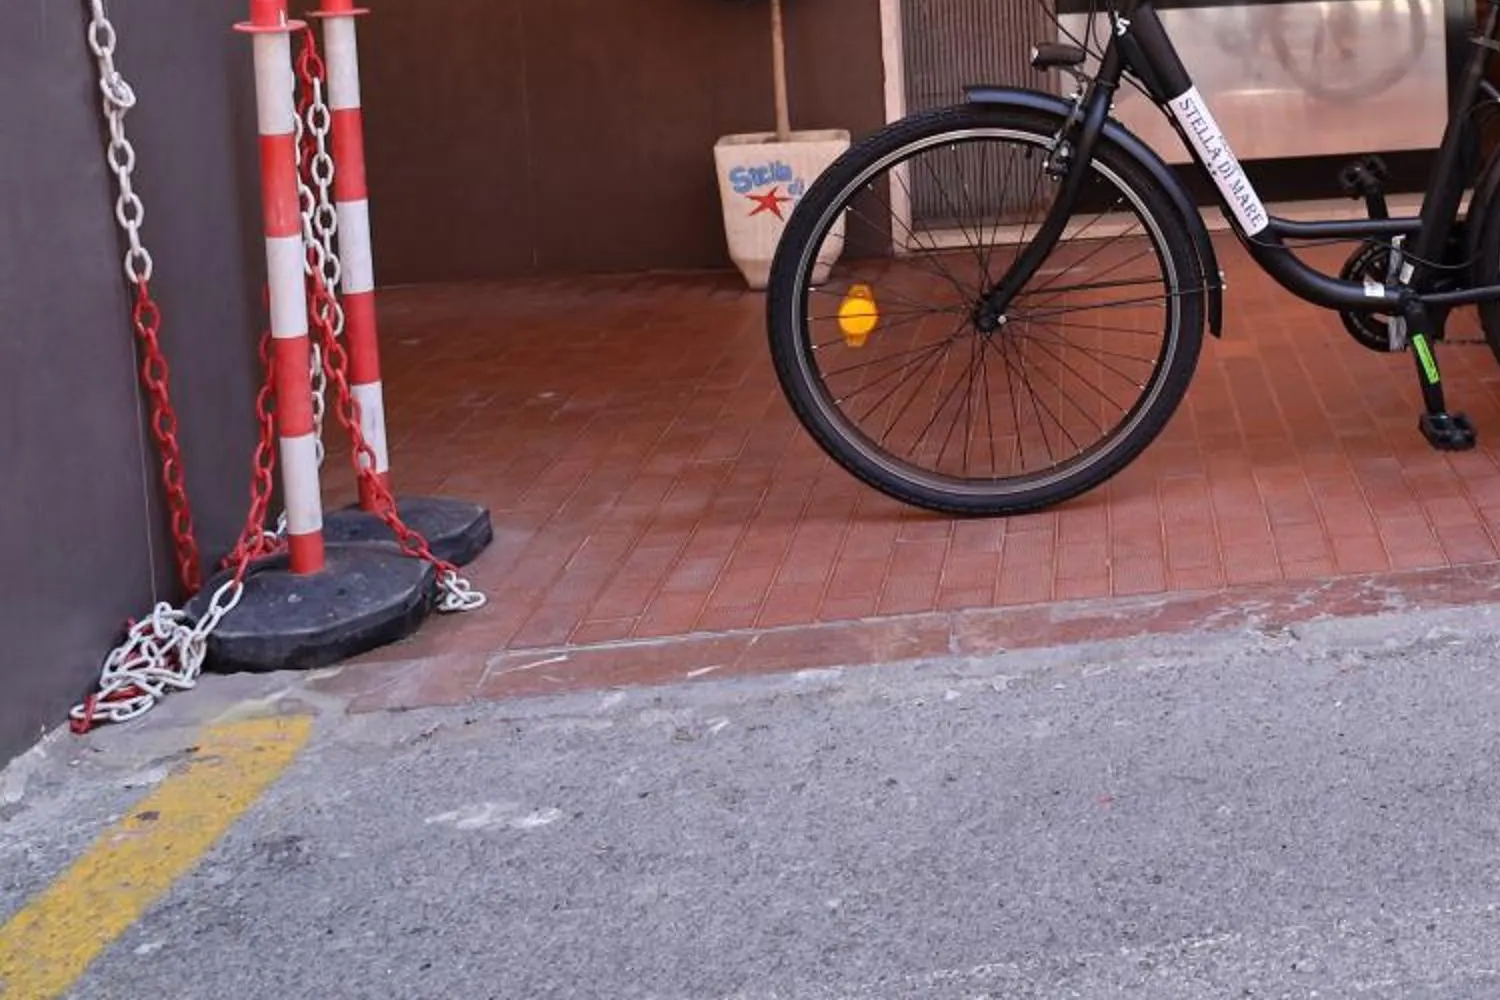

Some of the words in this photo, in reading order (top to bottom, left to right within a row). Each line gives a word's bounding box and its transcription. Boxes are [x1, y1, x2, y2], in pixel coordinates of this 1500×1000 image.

[1179, 98, 1222, 160] STELLA
[1218, 161, 1236, 179] DI
[1231, 179, 1264, 228] MARE
